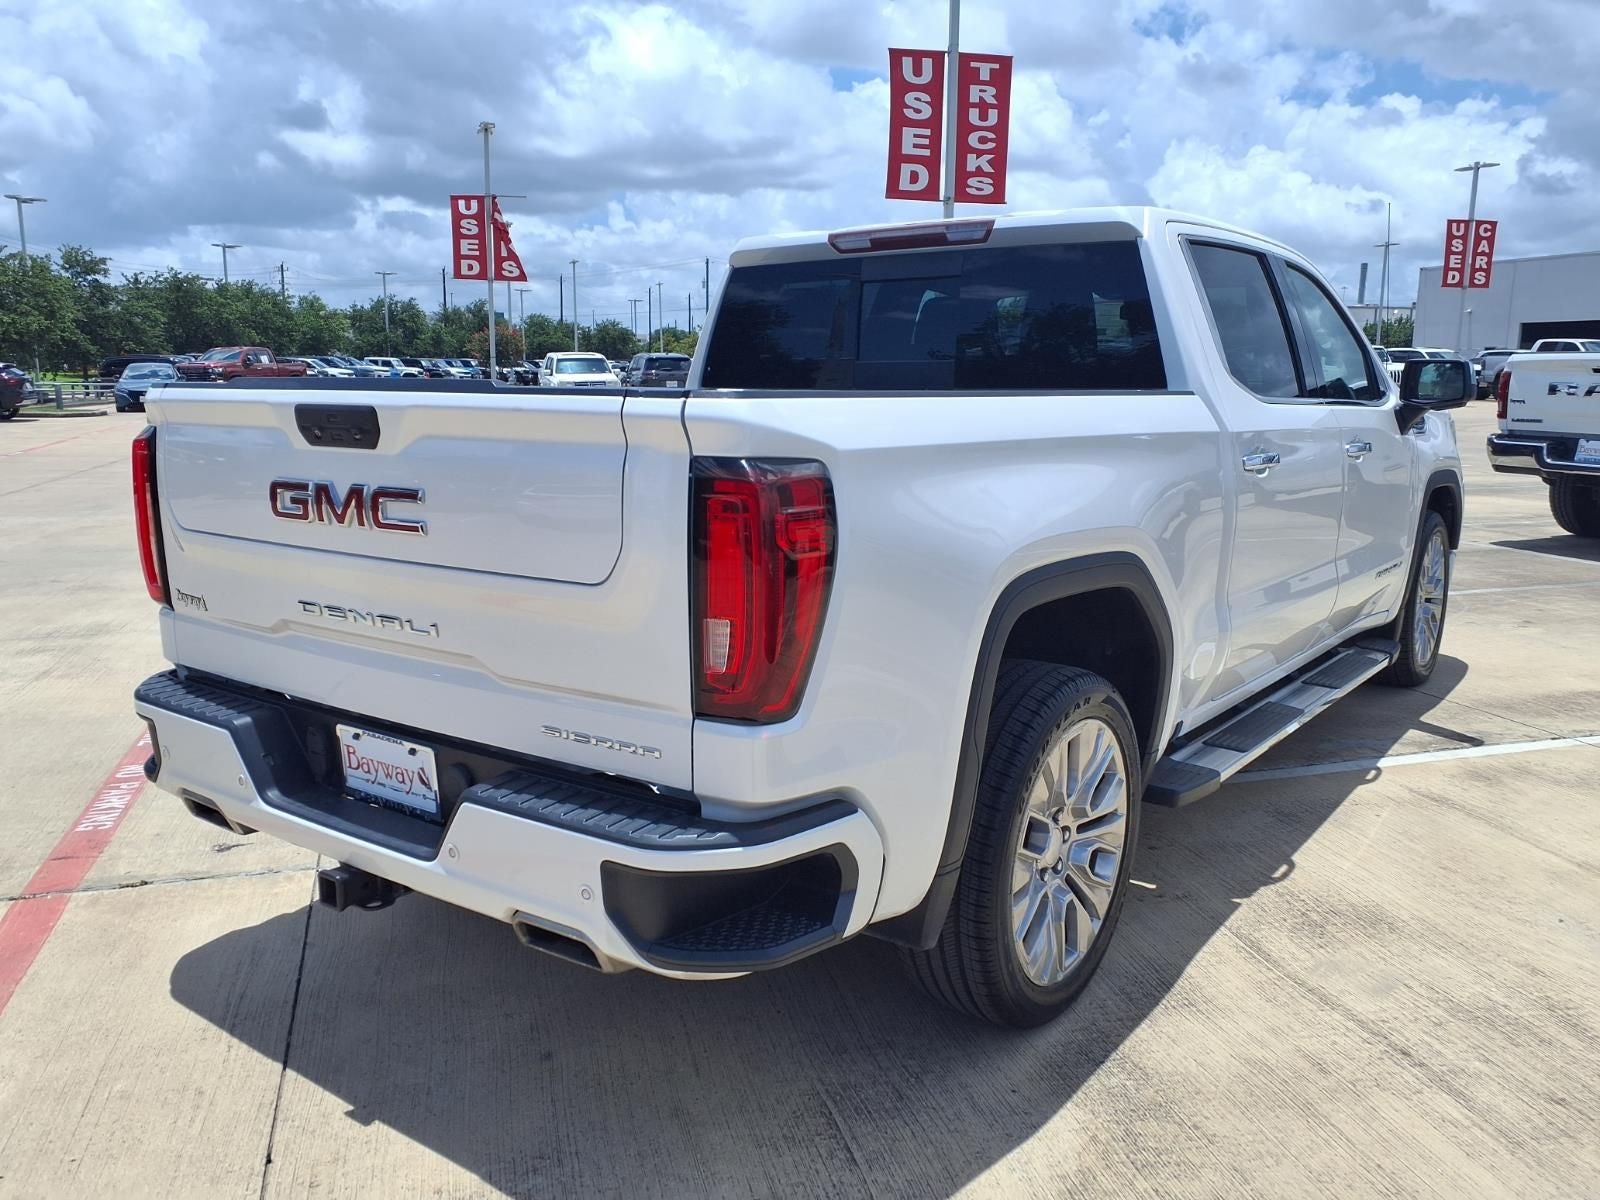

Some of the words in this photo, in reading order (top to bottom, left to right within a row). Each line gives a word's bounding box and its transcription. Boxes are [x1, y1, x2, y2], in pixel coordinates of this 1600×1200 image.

[899, 57, 933, 191] USED
[966, 62, 1000, 195] TRUCKS
[458, 199, 480, 275] USED
[1447, 223, 1465, 284] USED
[1474, 224, 1492, 284] CARS
[269, 477, 428, 536] GMC
[297, 599, 440, 638] DENALI
[344, 743, 415, 795] Bayway
[541, 724, 662, 759] SIERRA
[74, 781, 141, 832] PARKING
